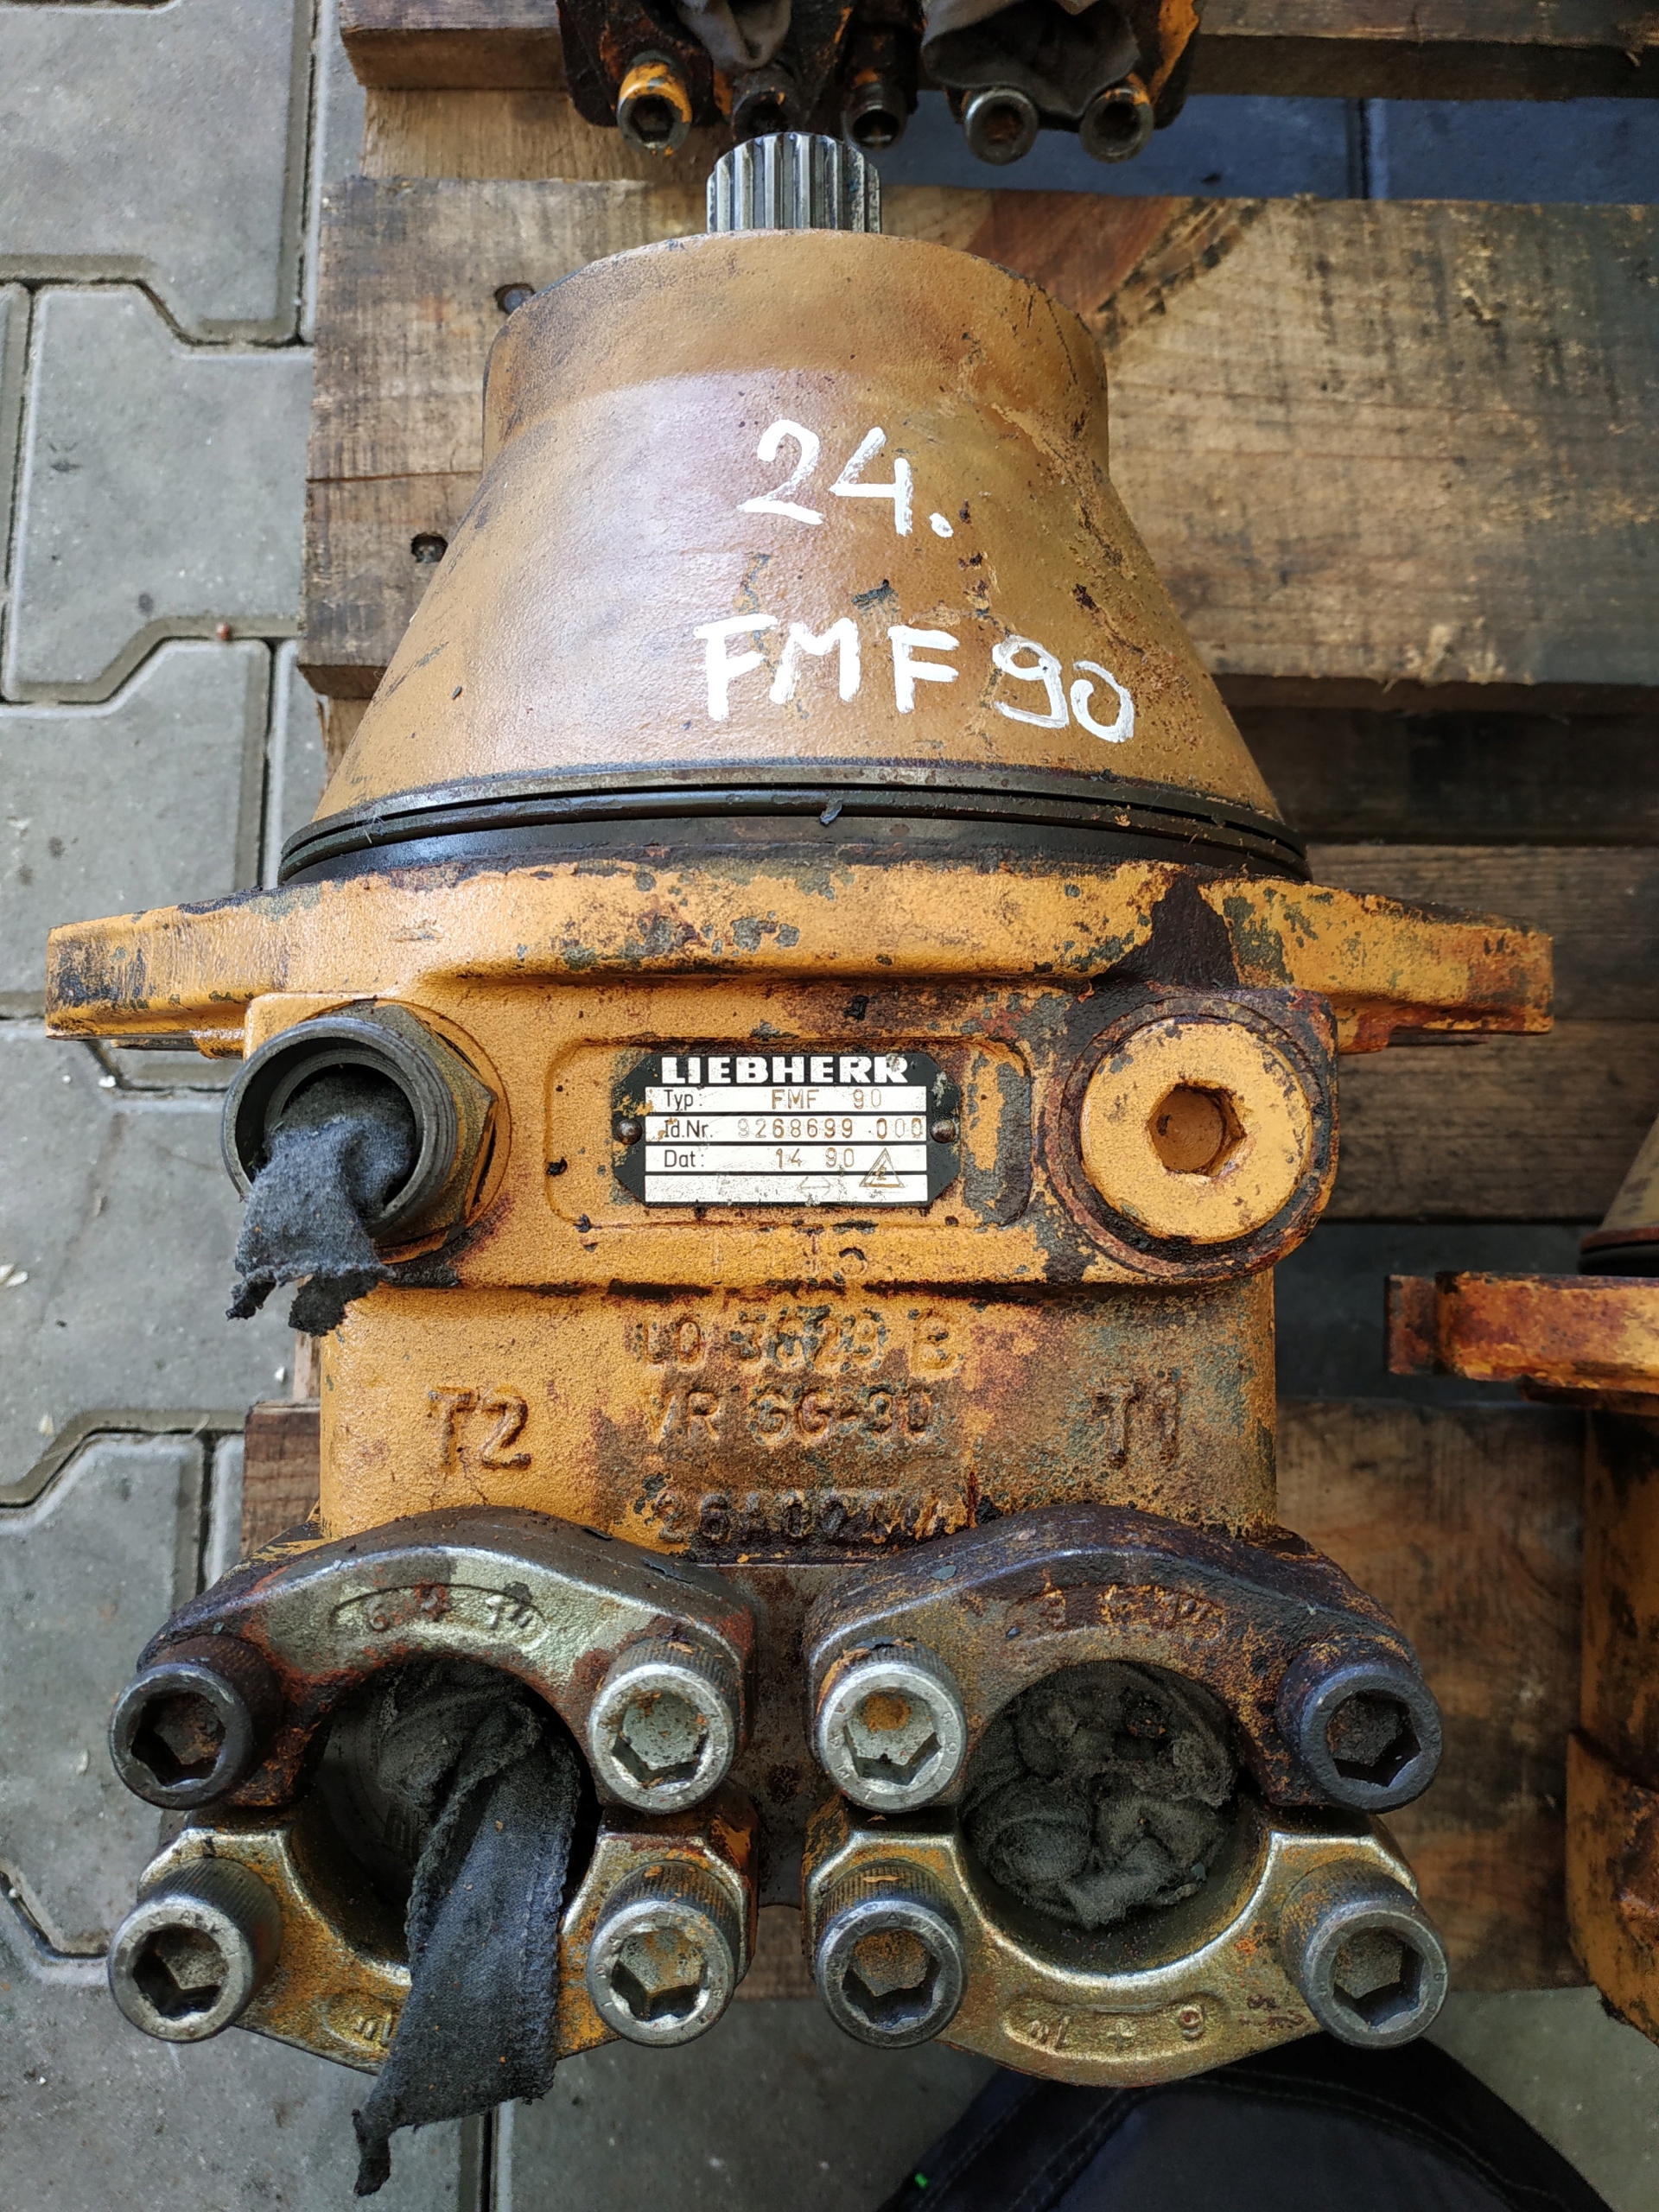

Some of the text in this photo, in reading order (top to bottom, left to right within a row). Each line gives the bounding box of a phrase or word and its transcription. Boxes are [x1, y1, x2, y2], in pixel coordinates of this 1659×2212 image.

[736, 419, 954, 537] 24.
[694, 613, 1135, 743] FMF 90
[661, 1056, 909, 1084] LIEBHERR
[772, 1089, 820, 1109] FMF
[853, 1088, 882, 1109] 90
[737, 1117, 854, 1140] 9268699
[775, 1147, 802, 1167] 14
[824, 1147, 855, 1168] 90
[429, 1384, 532, 1471] T2
